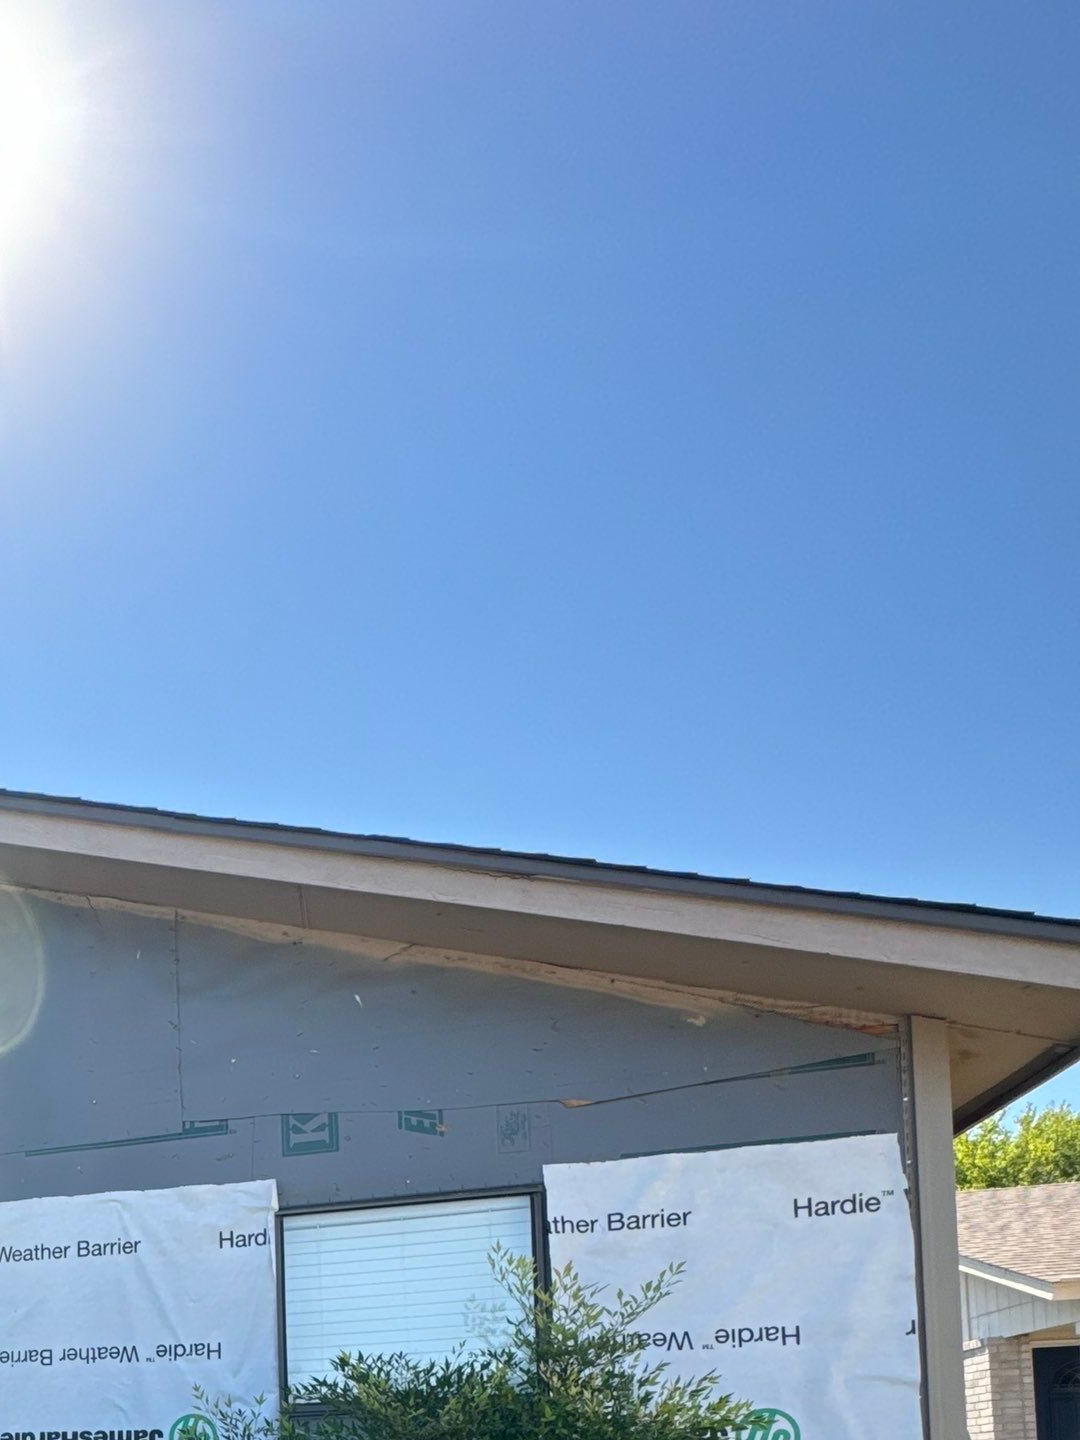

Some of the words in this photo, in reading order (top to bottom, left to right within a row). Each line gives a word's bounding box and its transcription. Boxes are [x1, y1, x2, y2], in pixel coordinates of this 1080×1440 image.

[607, 1208, 692, 1231] Barrier
[77, 1238, 141, 1258] Barrier
[59, 1345, 140, 1364] Weather
